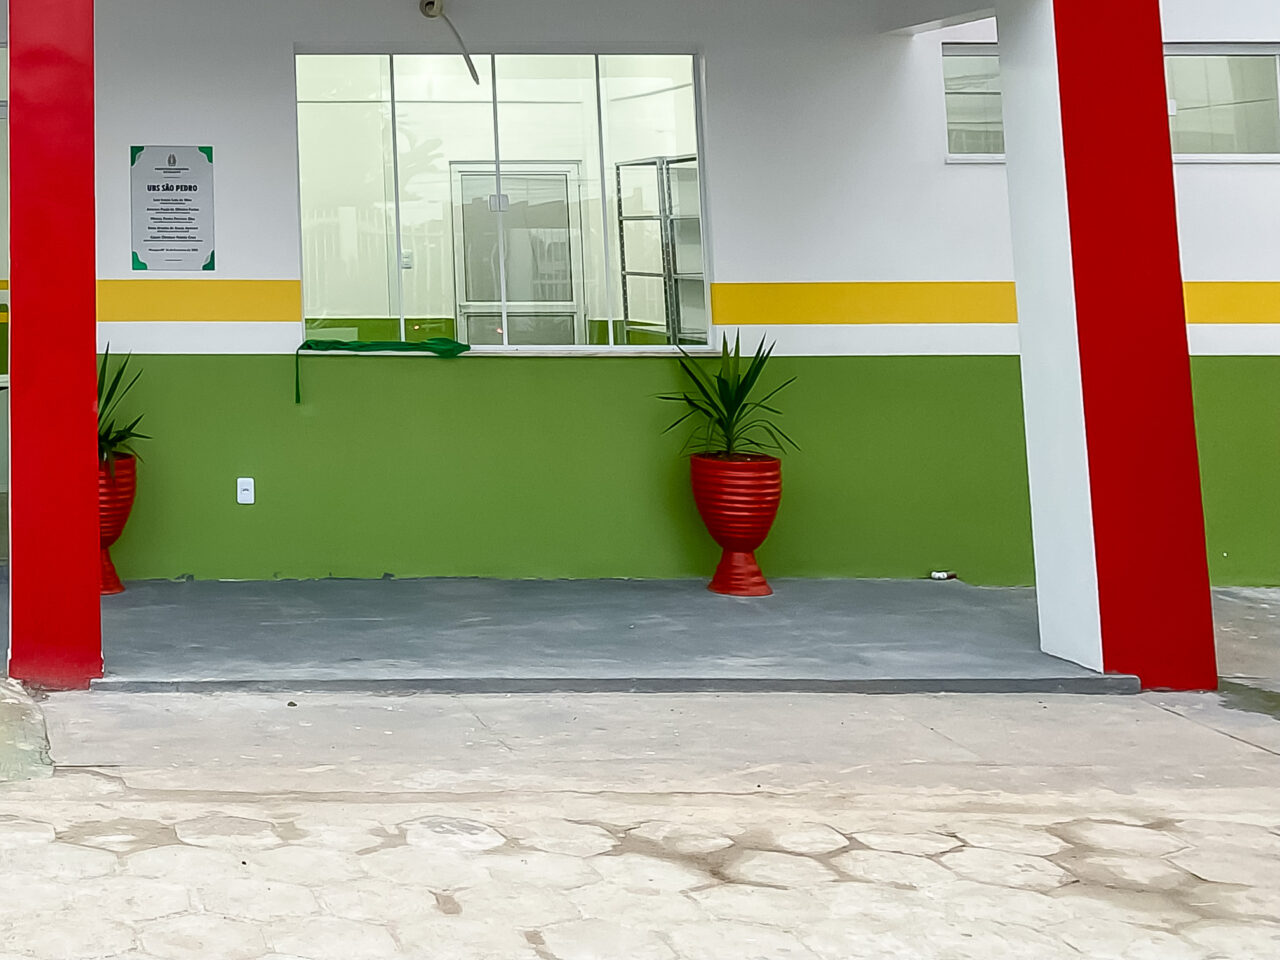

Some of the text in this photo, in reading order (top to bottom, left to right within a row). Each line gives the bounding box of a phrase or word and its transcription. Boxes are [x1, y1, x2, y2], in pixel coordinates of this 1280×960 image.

[147, 183, 198, 192] UBS SÃO PEDRO
